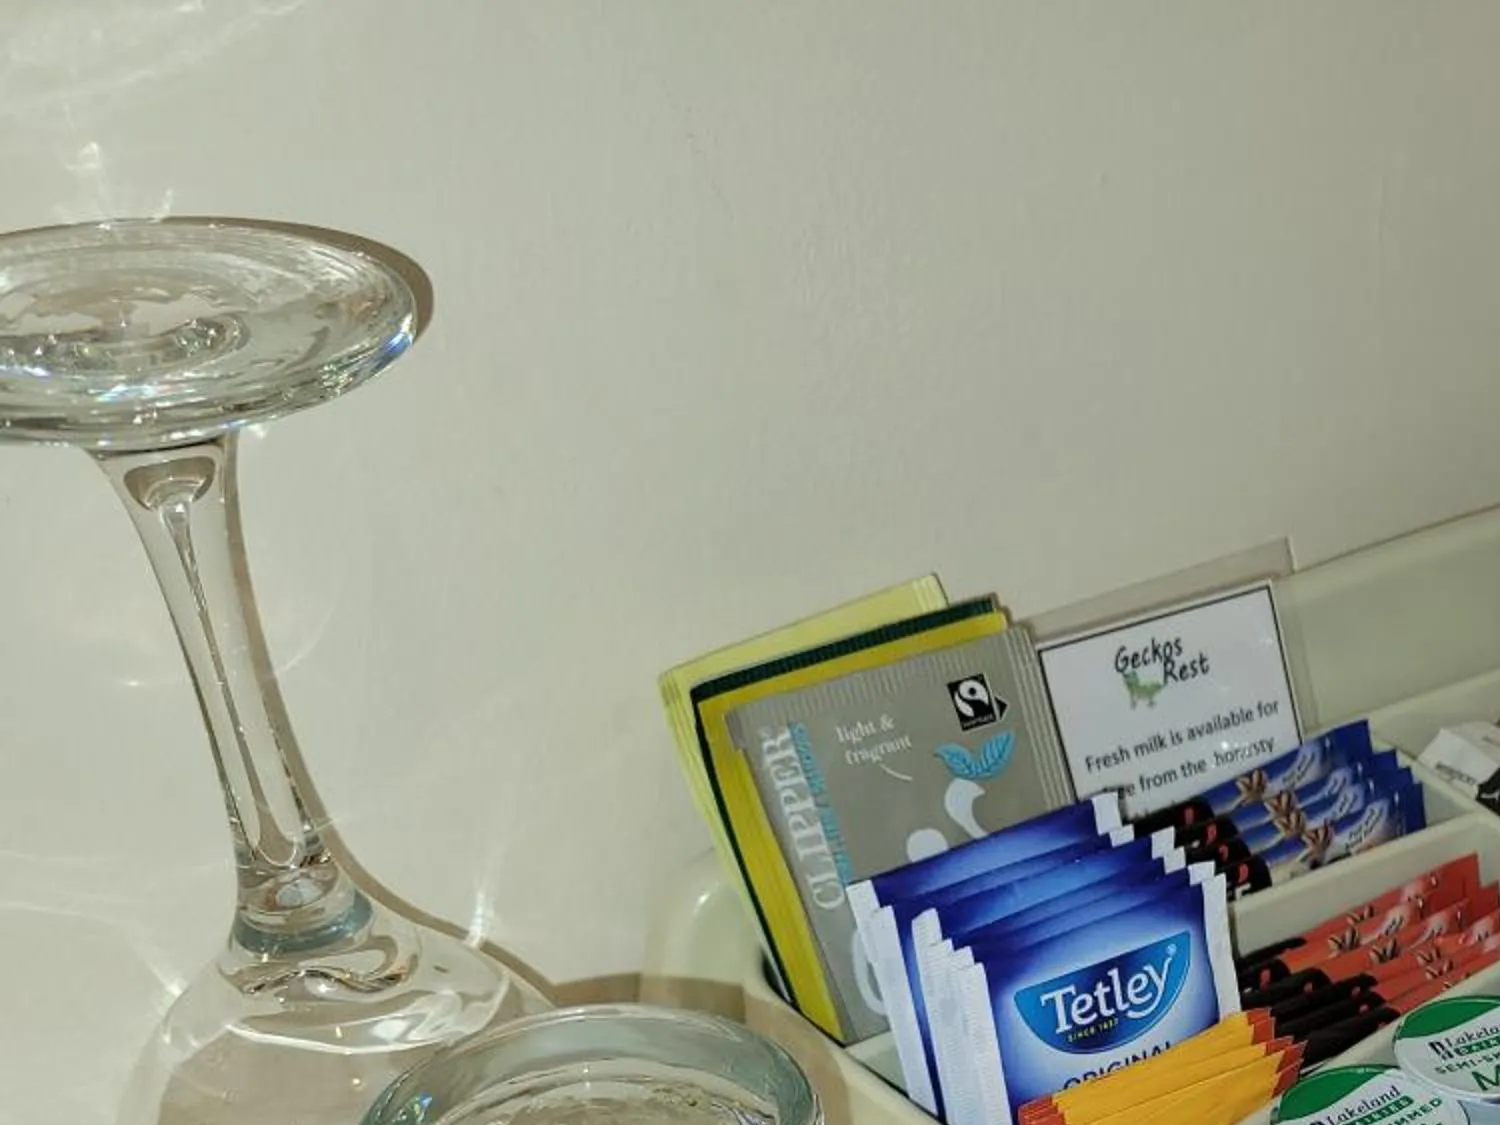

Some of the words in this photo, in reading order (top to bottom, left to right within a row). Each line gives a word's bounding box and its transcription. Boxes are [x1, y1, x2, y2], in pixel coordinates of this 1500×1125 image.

[1114, 637, 1184, 673] Geckos
[1163, 653, 1210, 686] Rest
[836, 720, 876, 743] light
[1085, 745, 1131, 773] Fresh
[1134, 733, 1168, 757] milk
[1170, 730, 1183, 746] is
[1187, 707, 1255, 740] available
[1257, 701, 1279, 719] for
[845, 734, 913, 766] fragrant
[1139, 769, 1178, 792] from
[1180, 759, 1207, 778] the
[762, 727, 847, 910] CLIPPER
[1040, 957, 1172, 1035] Tetley
